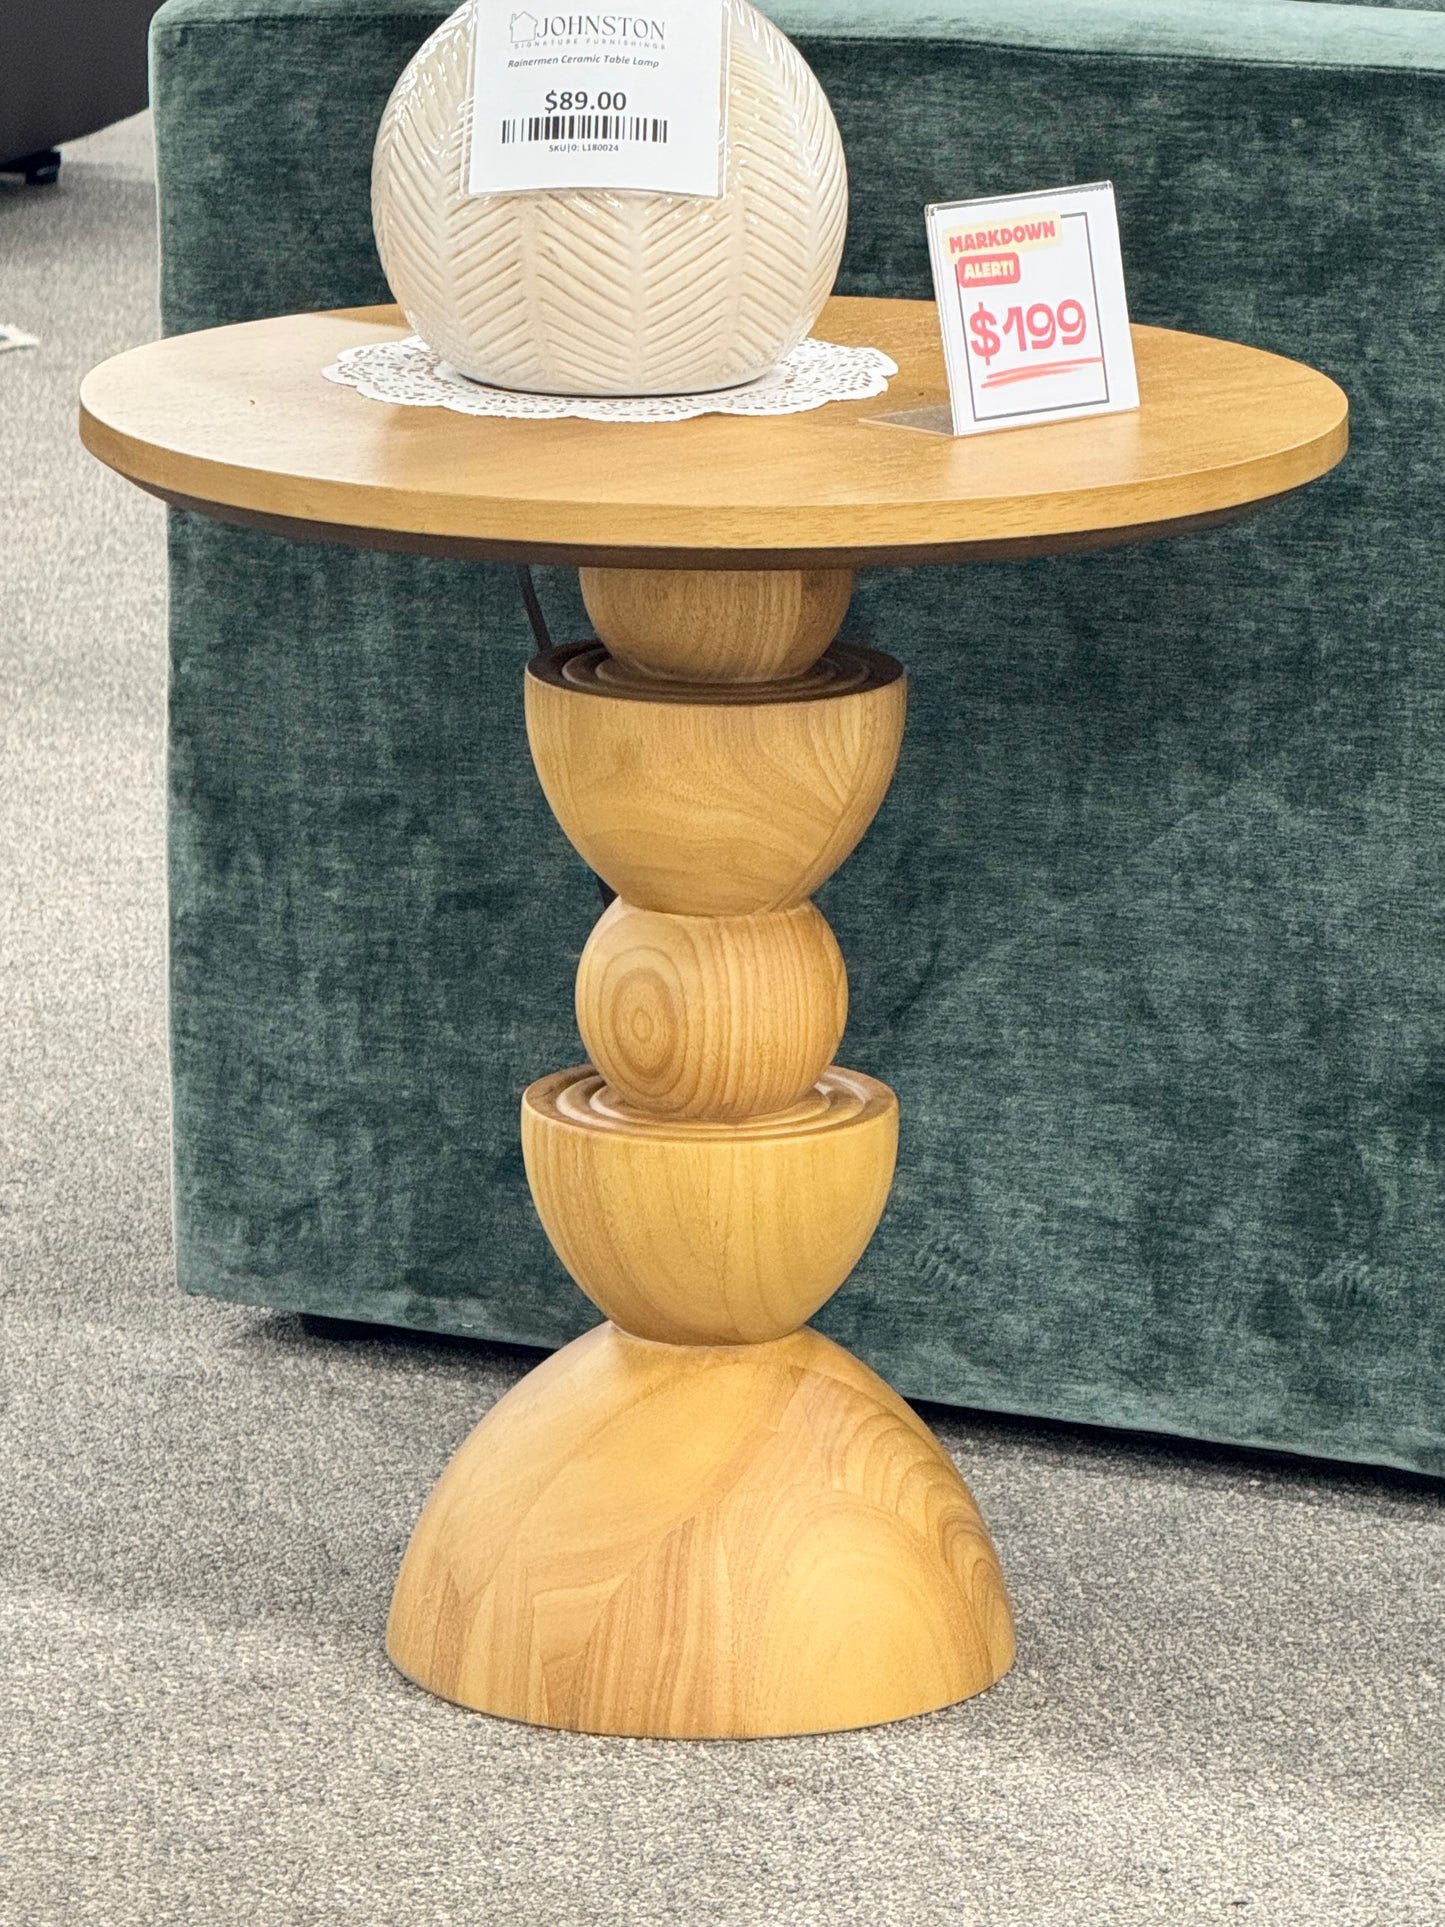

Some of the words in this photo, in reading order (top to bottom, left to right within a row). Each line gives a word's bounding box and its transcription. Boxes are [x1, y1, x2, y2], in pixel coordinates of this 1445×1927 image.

[537, 15, 665, 40] JOHNSTON
[514, 38, 578, 49] SIGNATURE
[586, 38, 666, 49] FURNISHINGS
[507, 55, 559, 68] Rainermen
[561, 54, 601, 64] Ceramic
[604, 54, 630, 65] Table
[633, 57, 660, 68] Lamp
[544, 89, 627, 114] $89.00
[582, 143, 619, 152] L180024
[949, 220, 1056, 253] MARKDOWN
[964, 260, 1015, 280] ALERT!
[969, 299, 1087, 366] $199
